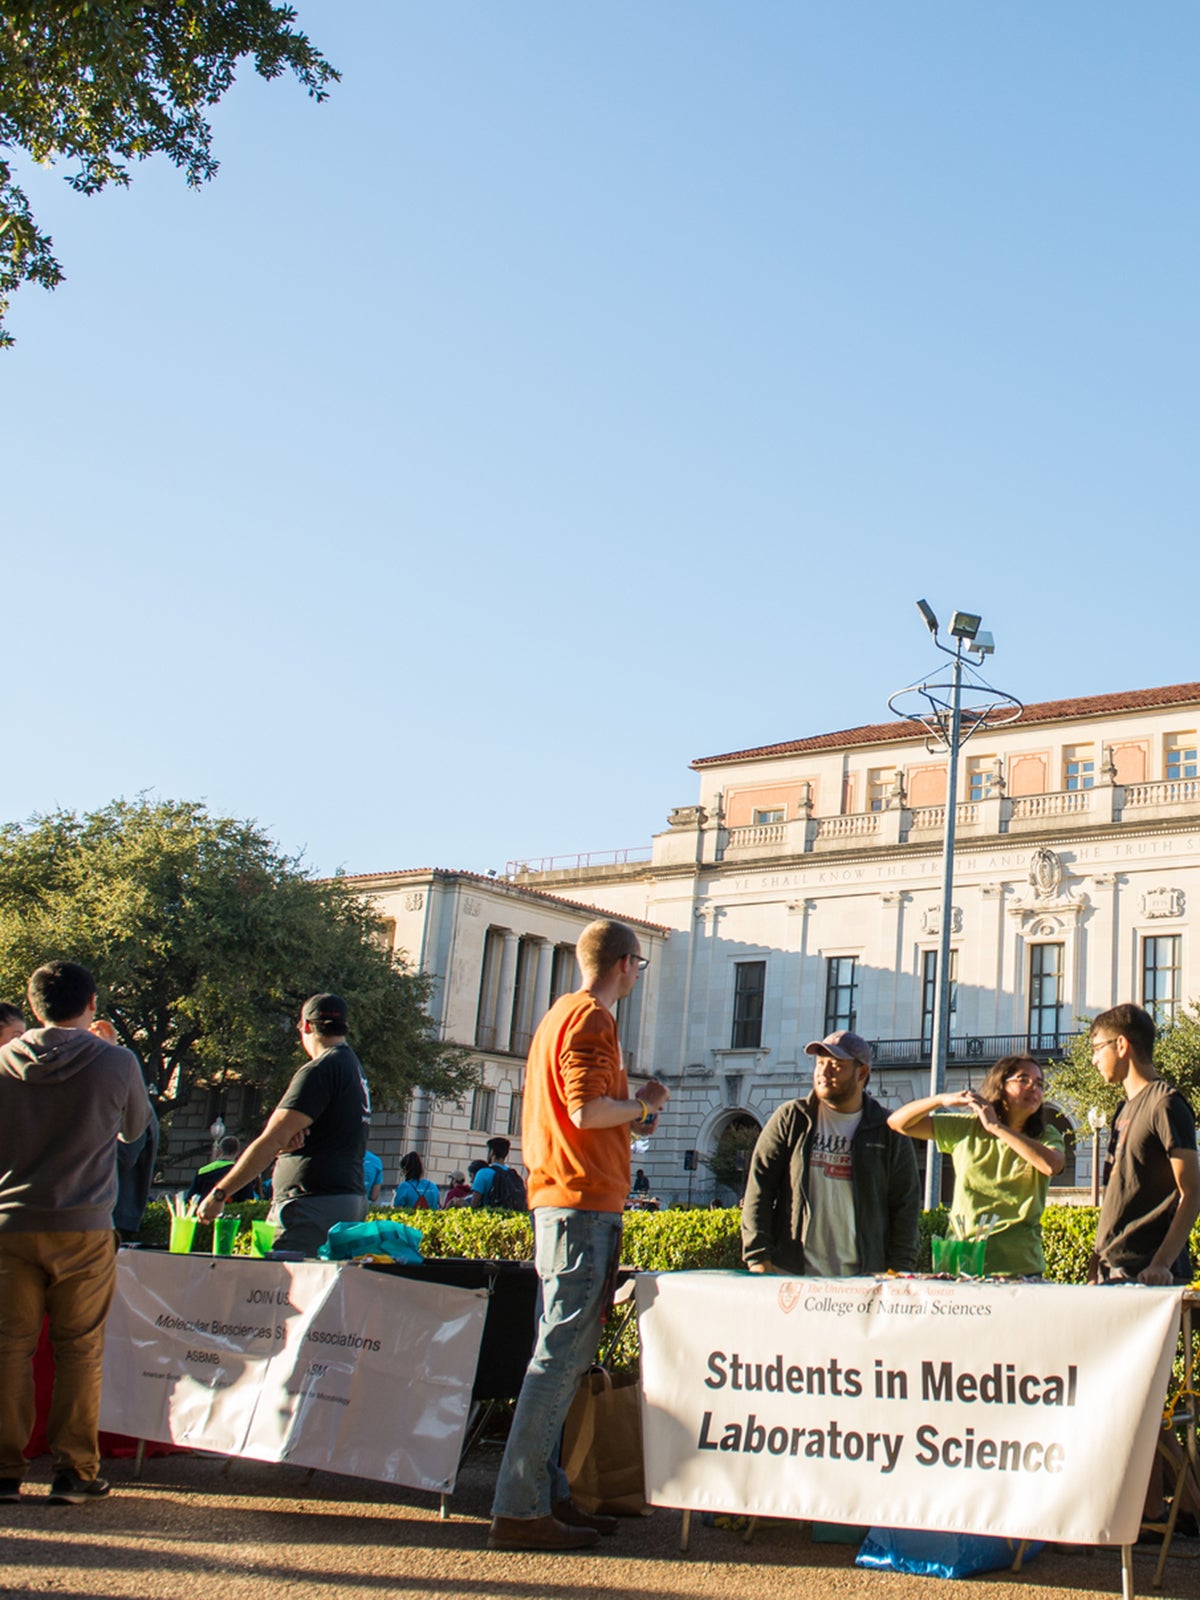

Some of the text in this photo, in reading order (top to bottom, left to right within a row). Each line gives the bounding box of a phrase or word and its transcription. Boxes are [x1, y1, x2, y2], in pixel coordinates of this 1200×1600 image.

[761, 875, 808, 887] SHALL
[819, 869, 866, 883] KNOW
[876, 865, 907, 877] THE
[919, 859, 977, 875] TRTH
[989, 854, 1027, 869] AND
[1113, 840, 1174, 857] TRUTH
[246, 1289, 274, 1305] JOIN
[804, 1296, 993, 1317] College of Natural Sciences
[155, 1314, 210, 1333] Molecular
[211, 1321, 272, 1341] Biosciences
[307, 1363, 328, 1377] SM
[704, 1350, 1078, 1407] Students in Medical
[697, 1411, 1066, 1474] Laboratory Science
